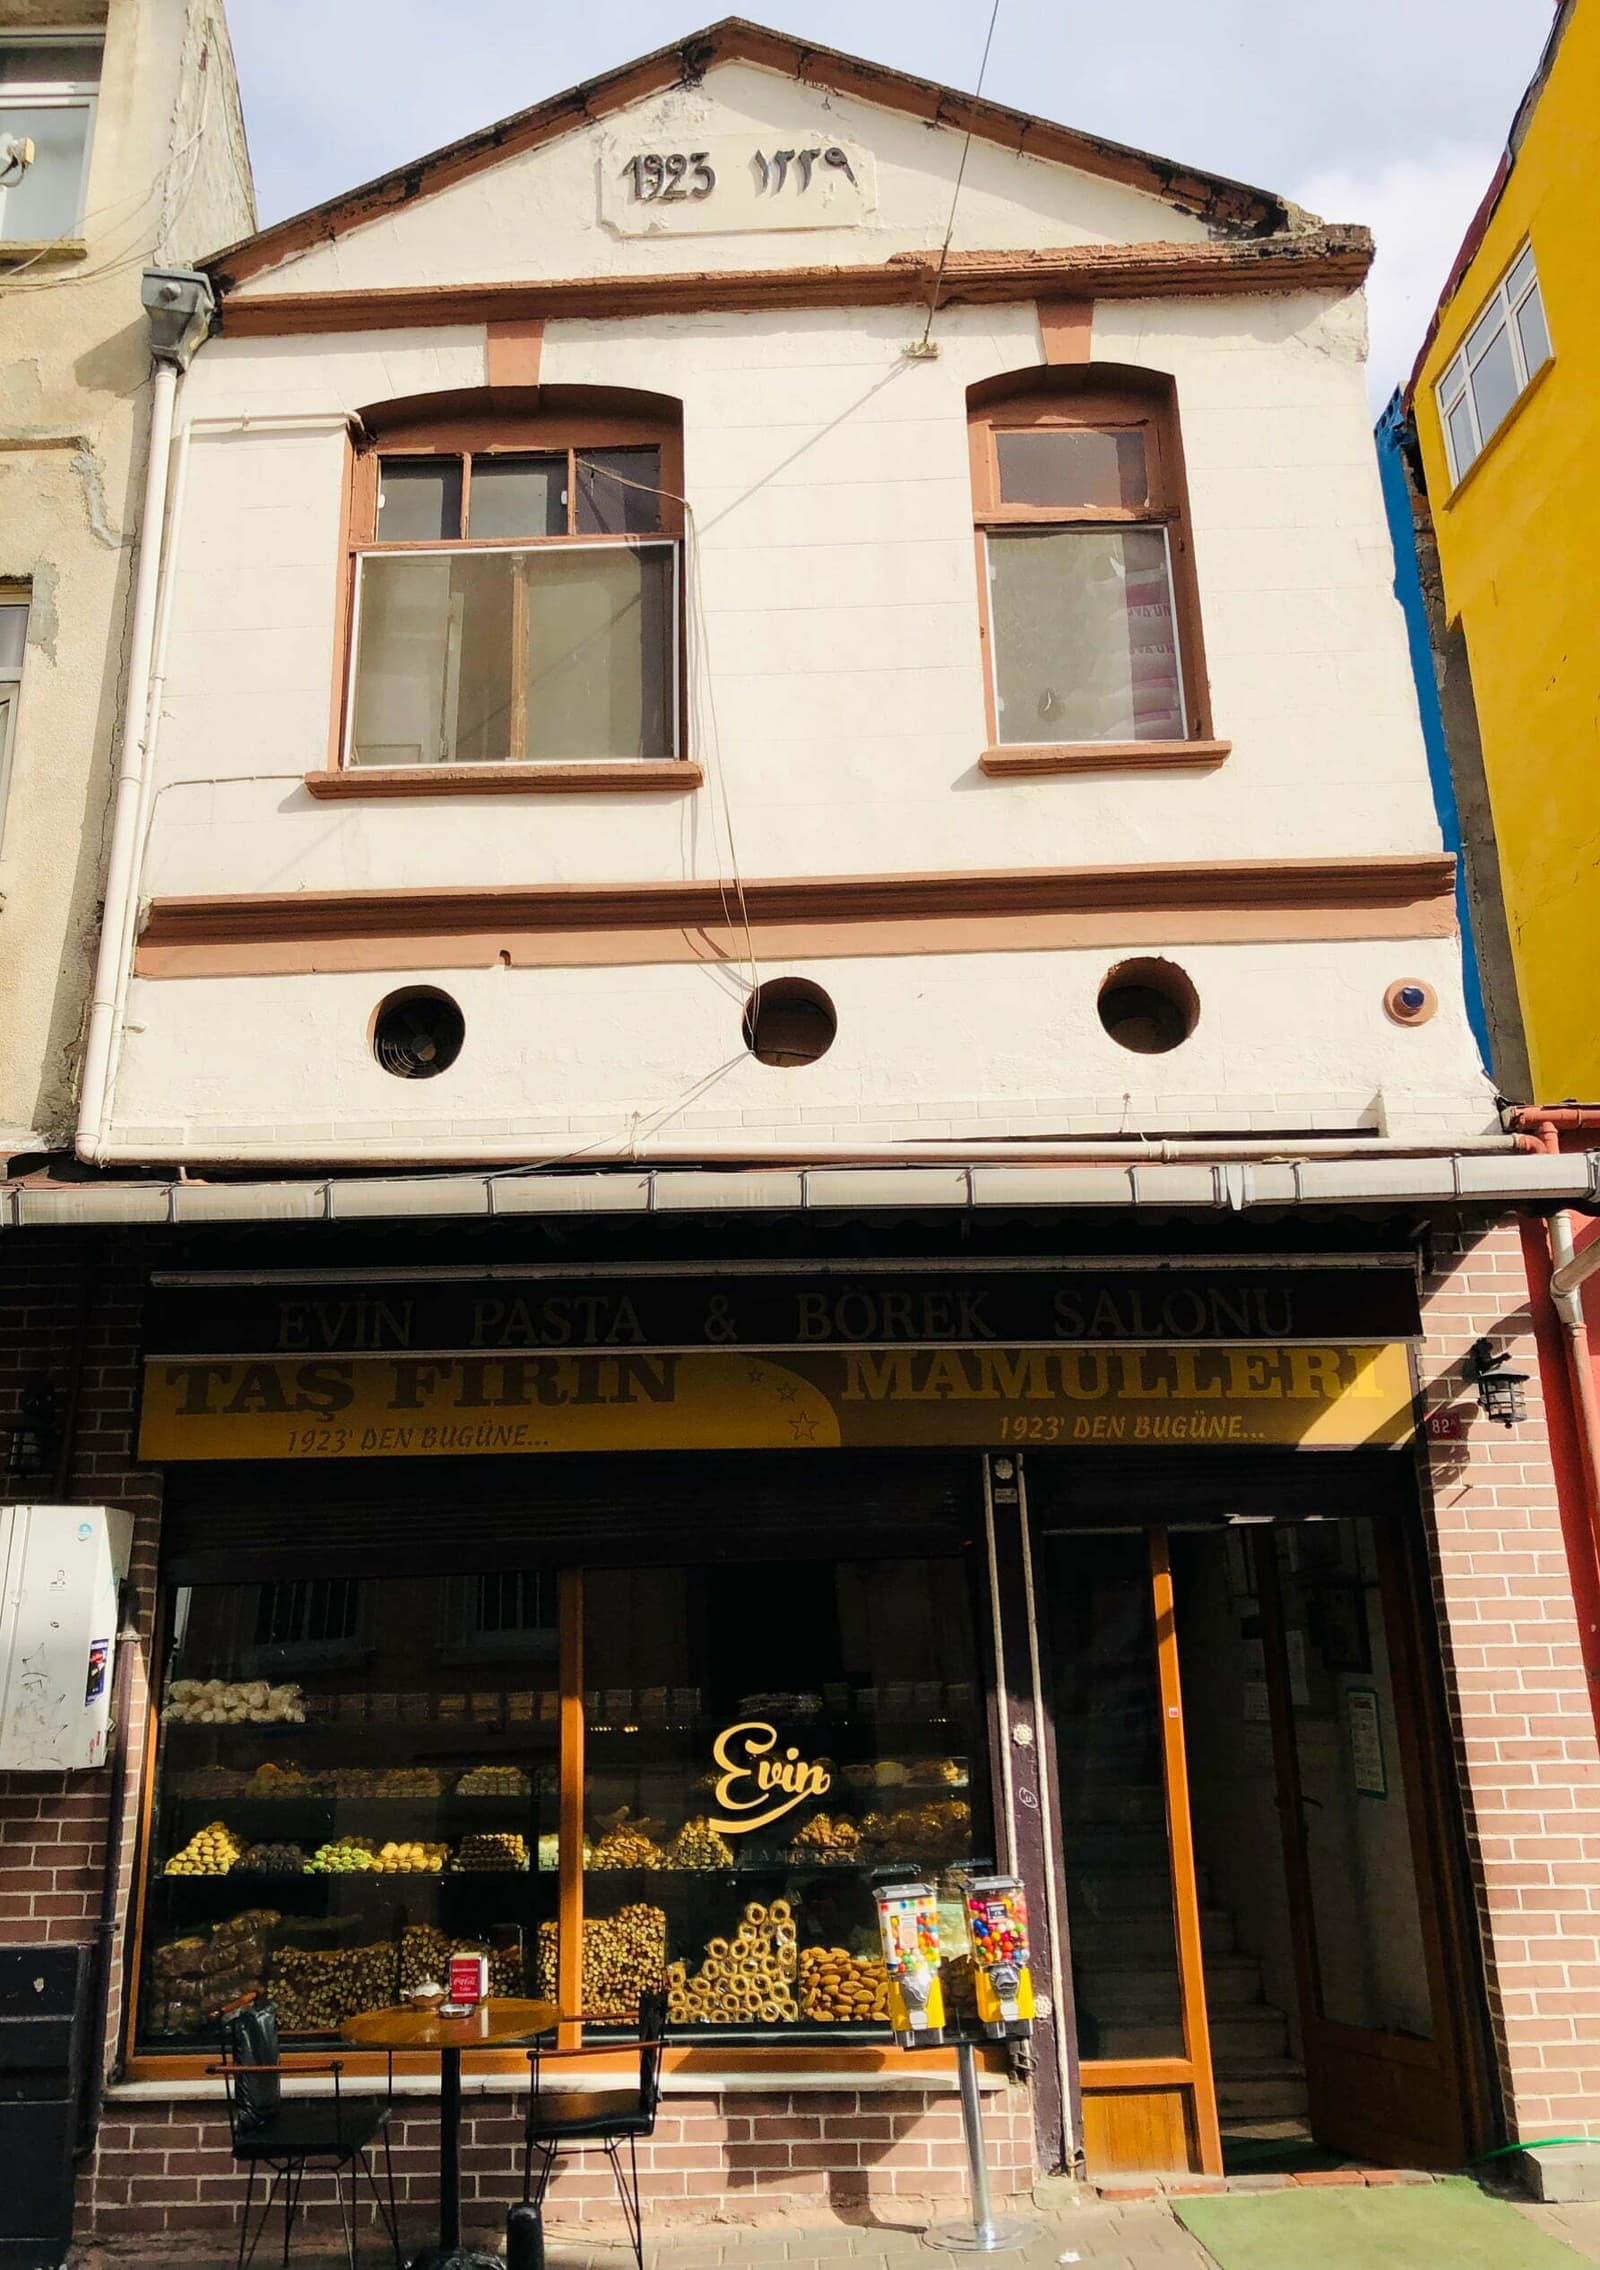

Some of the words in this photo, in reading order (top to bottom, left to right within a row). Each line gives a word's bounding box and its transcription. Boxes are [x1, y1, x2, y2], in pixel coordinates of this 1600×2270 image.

[622, 151, 716, 201] 1923
[274, 1291, 417, 1349] EVİN
[469, 1294, 648, 1347] PASTA
[703, 1295, 739, 1343] &
[794, 1284, 997, 1341] BÖREK
[1053, 1287, 1295, 1338] SALONU
[165, 1359, 356, 1422] TAŞ
[386, 1352, 682, 1409] FIRIN
[360, 1427, 414, 1450] DEN
[420, 1420, 550, 1449] BUGÜNE...
[1071, 1415, 1128, 1439] DEN
[1133, 1409, 1267, 1440] BUGÜNE...
[1431, 1418, 1451, 1434] 82
[709, 1721, 831, 1834] Evin
